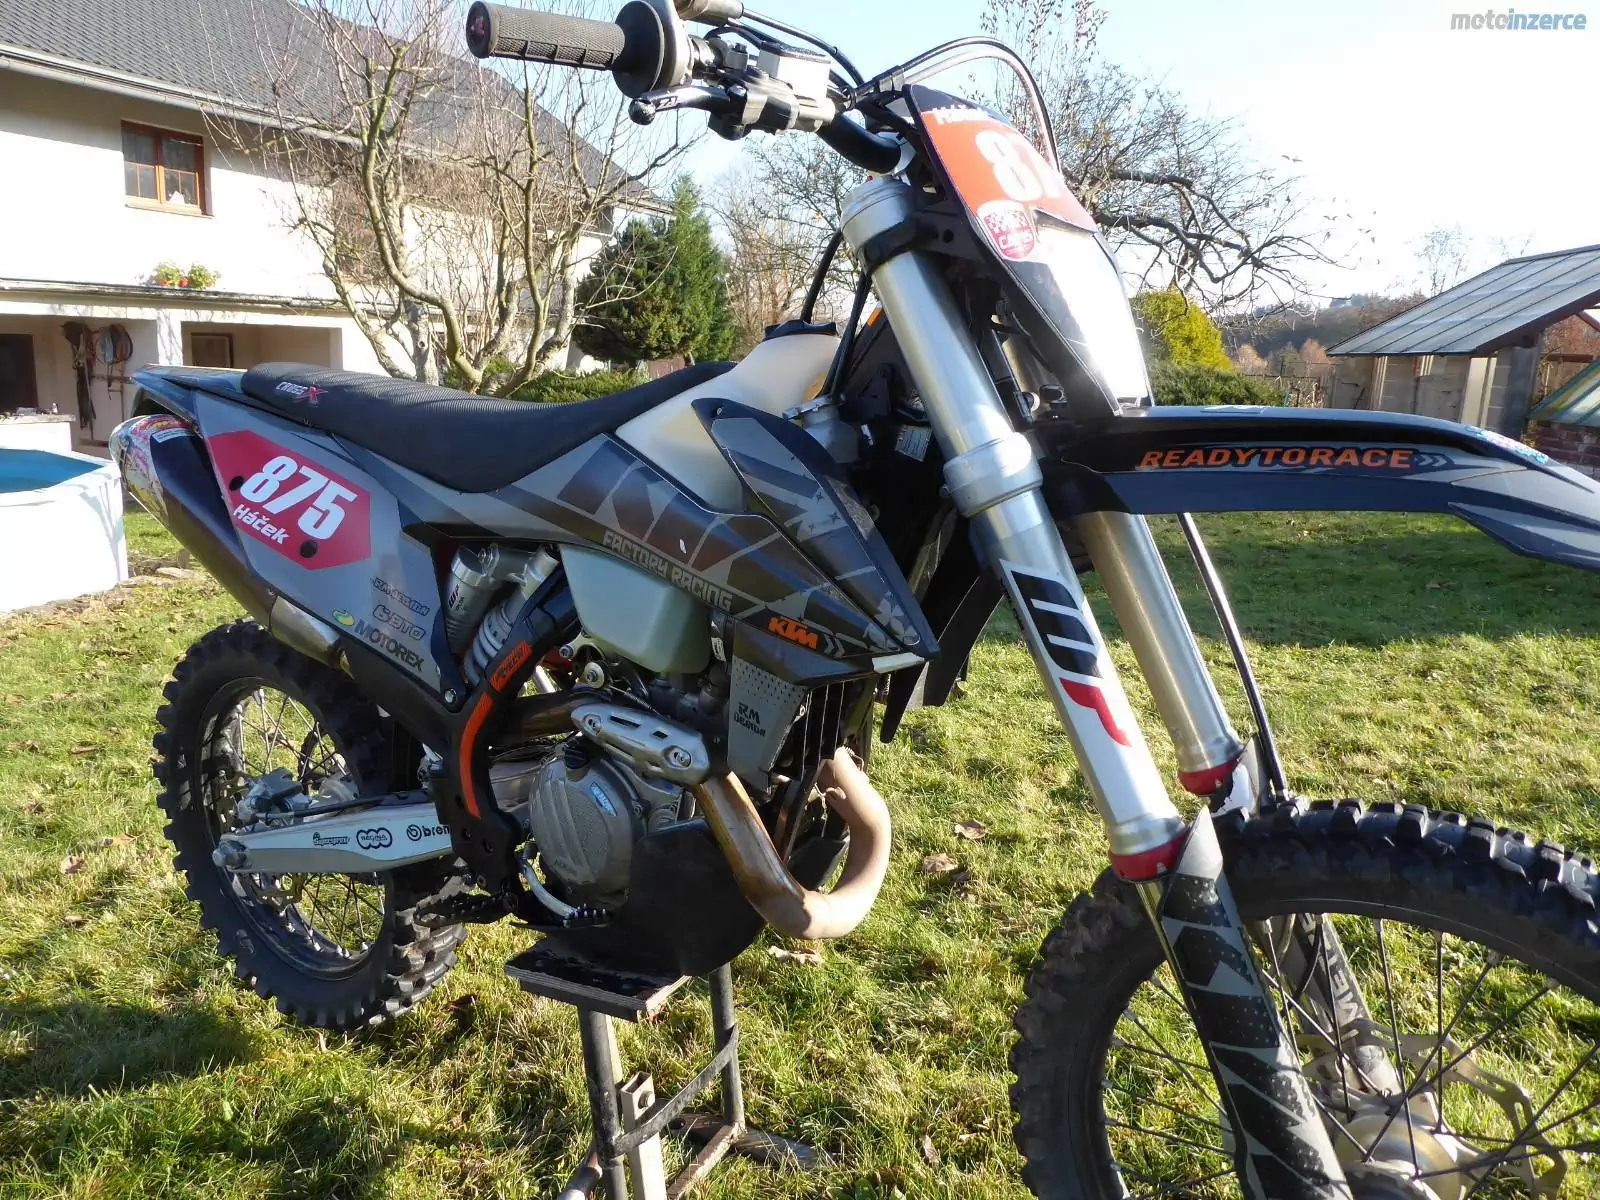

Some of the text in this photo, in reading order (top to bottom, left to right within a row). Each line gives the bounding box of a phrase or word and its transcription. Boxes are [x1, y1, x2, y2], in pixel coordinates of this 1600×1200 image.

[239, 455, 359, 541] 875
[232, 503, 290, 545] Háček
[602, 529, 734, 612] FACTORY RACING
[354, 618, 425, 673] MOTOREX
[767, 616, 819, 650] KTM
[738, 702, 761, 725] RM
